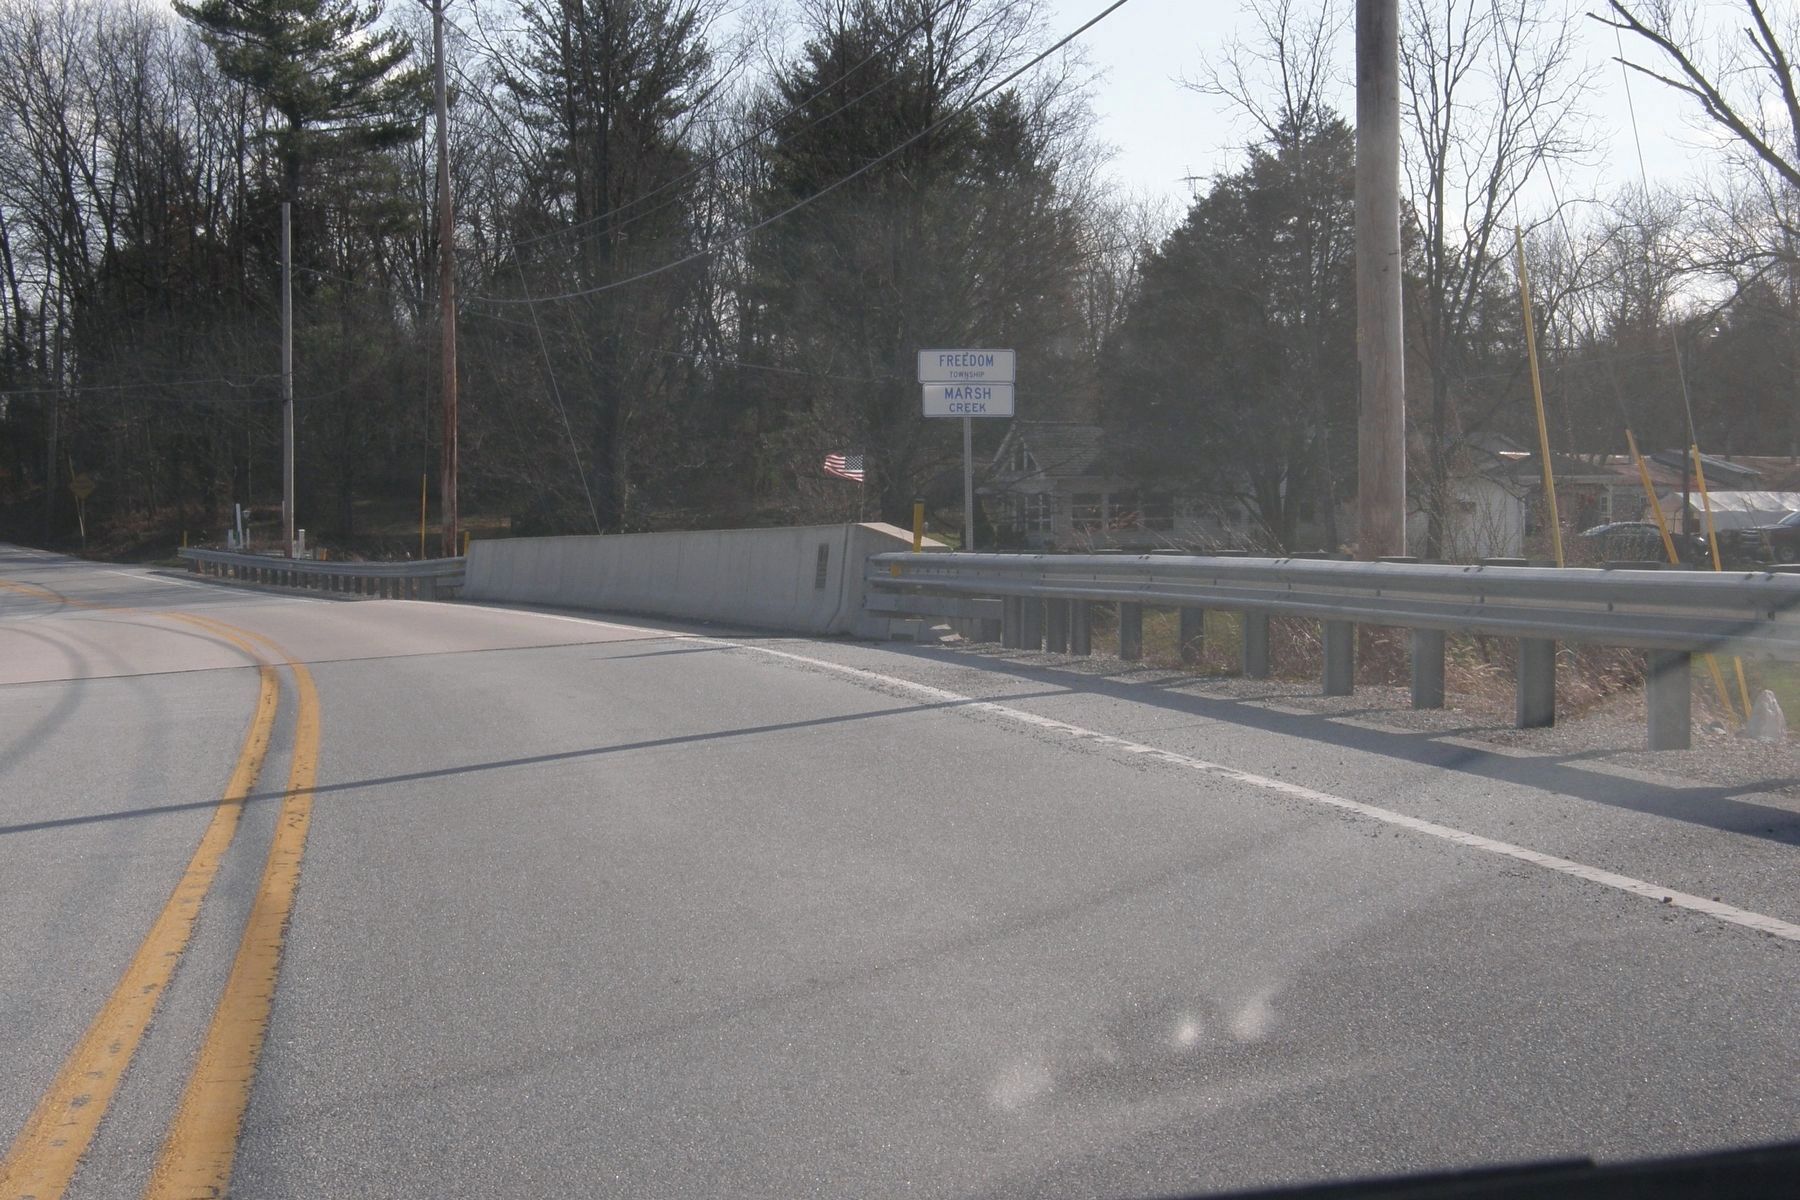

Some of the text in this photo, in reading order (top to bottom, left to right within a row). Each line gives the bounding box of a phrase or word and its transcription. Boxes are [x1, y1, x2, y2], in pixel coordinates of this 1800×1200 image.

[939, 355, 994, 367] FREEDOM
[944, 387, 991, 400] MARSH
[949, 403, 986, 413] CREEK
